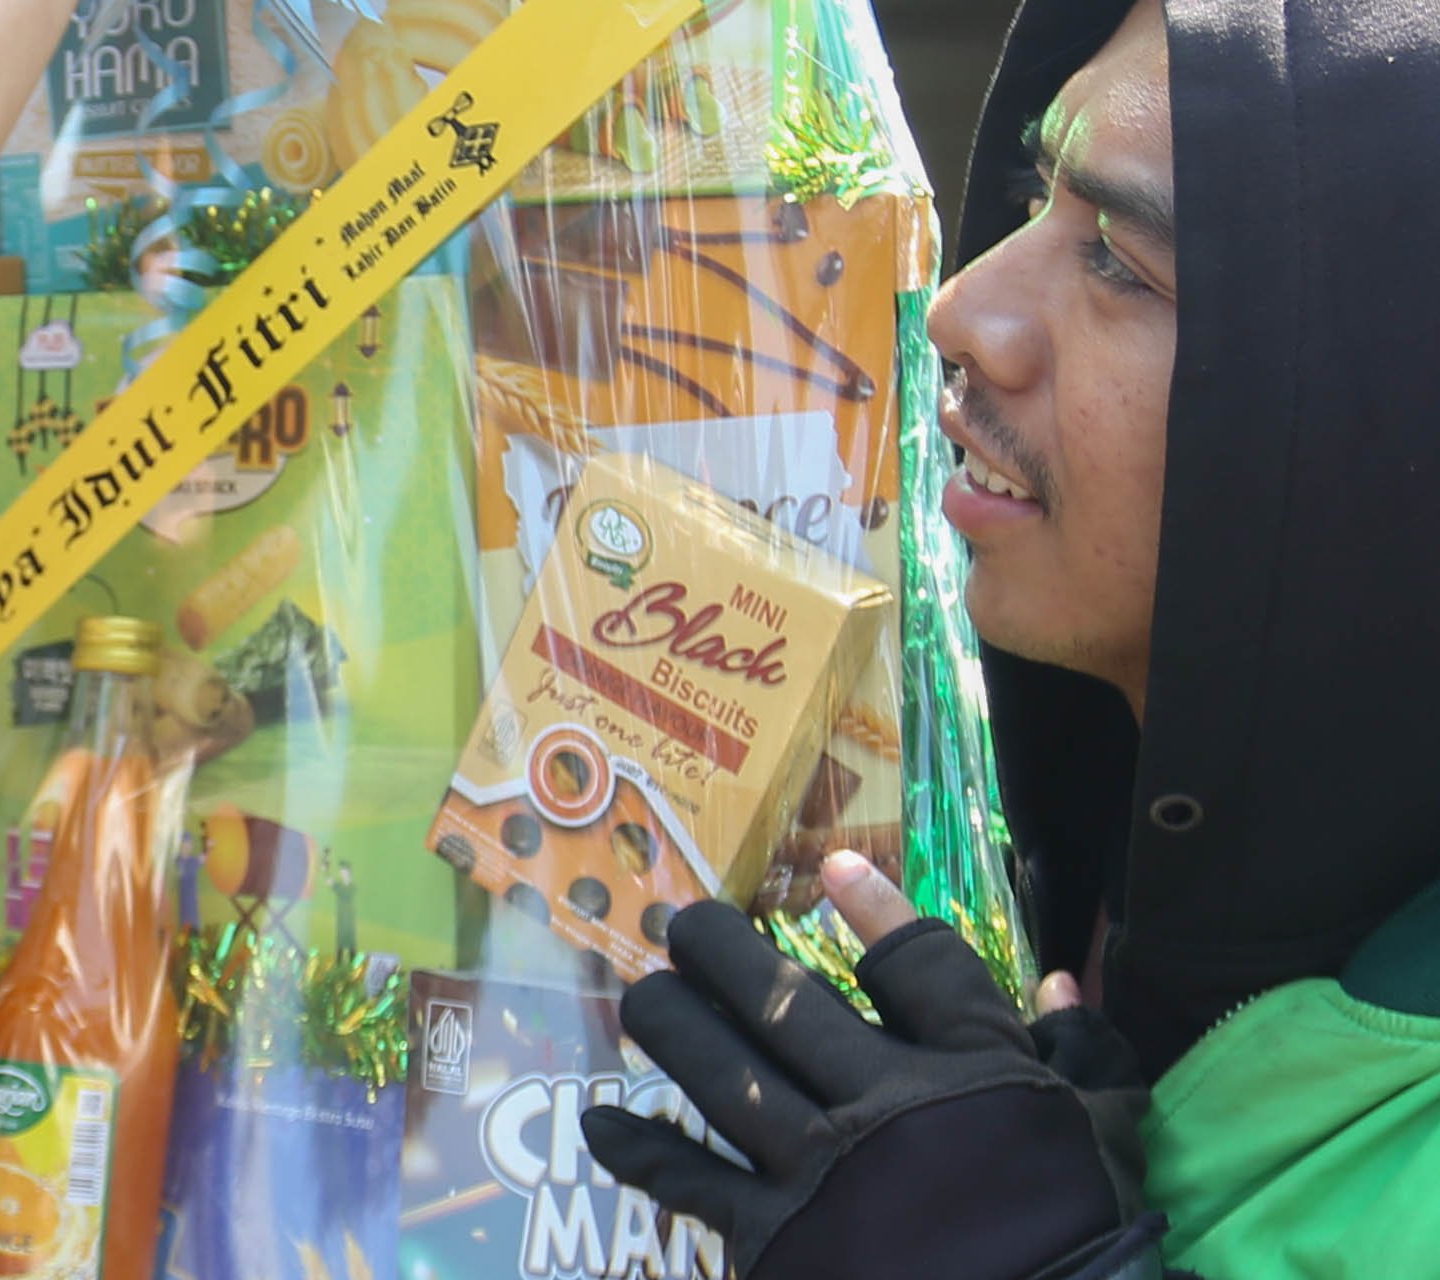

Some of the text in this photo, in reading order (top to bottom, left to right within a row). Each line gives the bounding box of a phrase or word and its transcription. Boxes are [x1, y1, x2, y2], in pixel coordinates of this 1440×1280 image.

[49, 404, 176, 550] Idul
[188, 266, 332, 434] Fitri
[593, 581, 788, 686] Black
[729, 583, 788, 633] MINI
[594, 714, 646, 750] one
[650, 657, 760, 739] Biscuits
